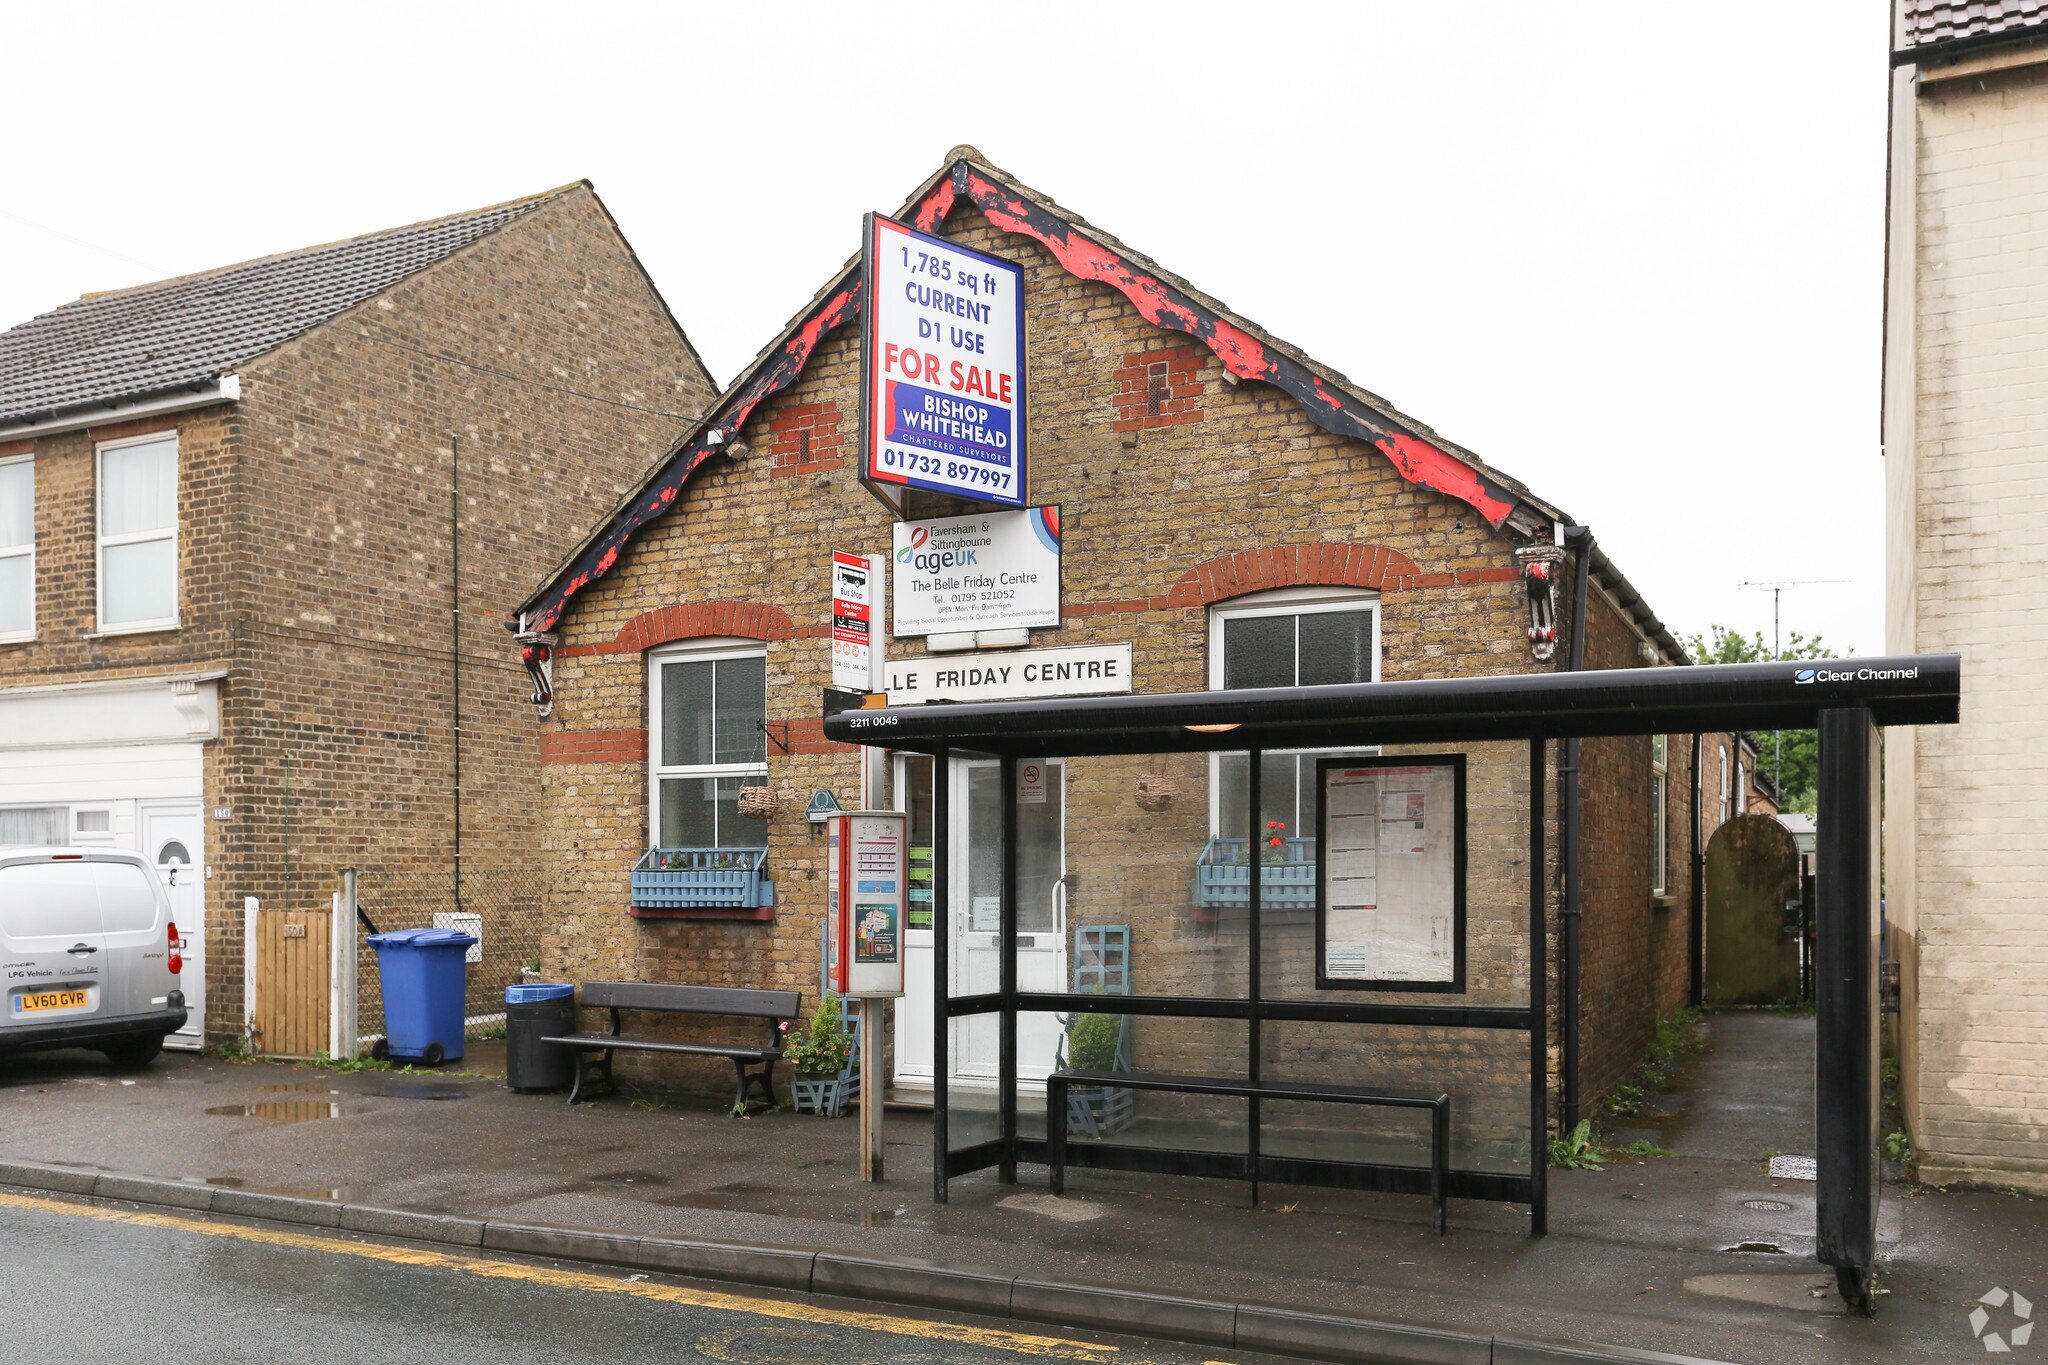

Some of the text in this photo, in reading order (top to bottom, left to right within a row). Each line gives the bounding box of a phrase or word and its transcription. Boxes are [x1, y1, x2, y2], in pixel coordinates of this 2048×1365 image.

[901, 247, 996, 295] 1,785 sq ft
[905, 282, 991, 324] CURRENT
[919, 318, 985, 354] D1 USE
[885, 342, 1011, 403] FOR SALE
[924, 395, 988, 425] BISHOP
[902, 409, 1007, 448] WHITEHEAD
[902, 433, 1006, 463] CHARTERED SURVEYORS
[884, 448, 1011, 489] 01732 897997
[931, 521, 990, 537] Faversham &
[931, 537, 992, 551] Sittingbourne
[841, 588, 863, 600] Bus Stop
[912, 572, 1037, 592] The Belle Friday Centre
[951, 592, 977, 603] 01795
[981, 590, 1015, 601] 521052
[936, 666, 1012, 688] FRIDAY
[1023, 659, 1117, 682] CENTRE
[1817, 667, 1918, 682] Clear Channel
[850, 715, 898, 728] 3211 0045
[23, 992, 84, 1009] LV60 GVR
